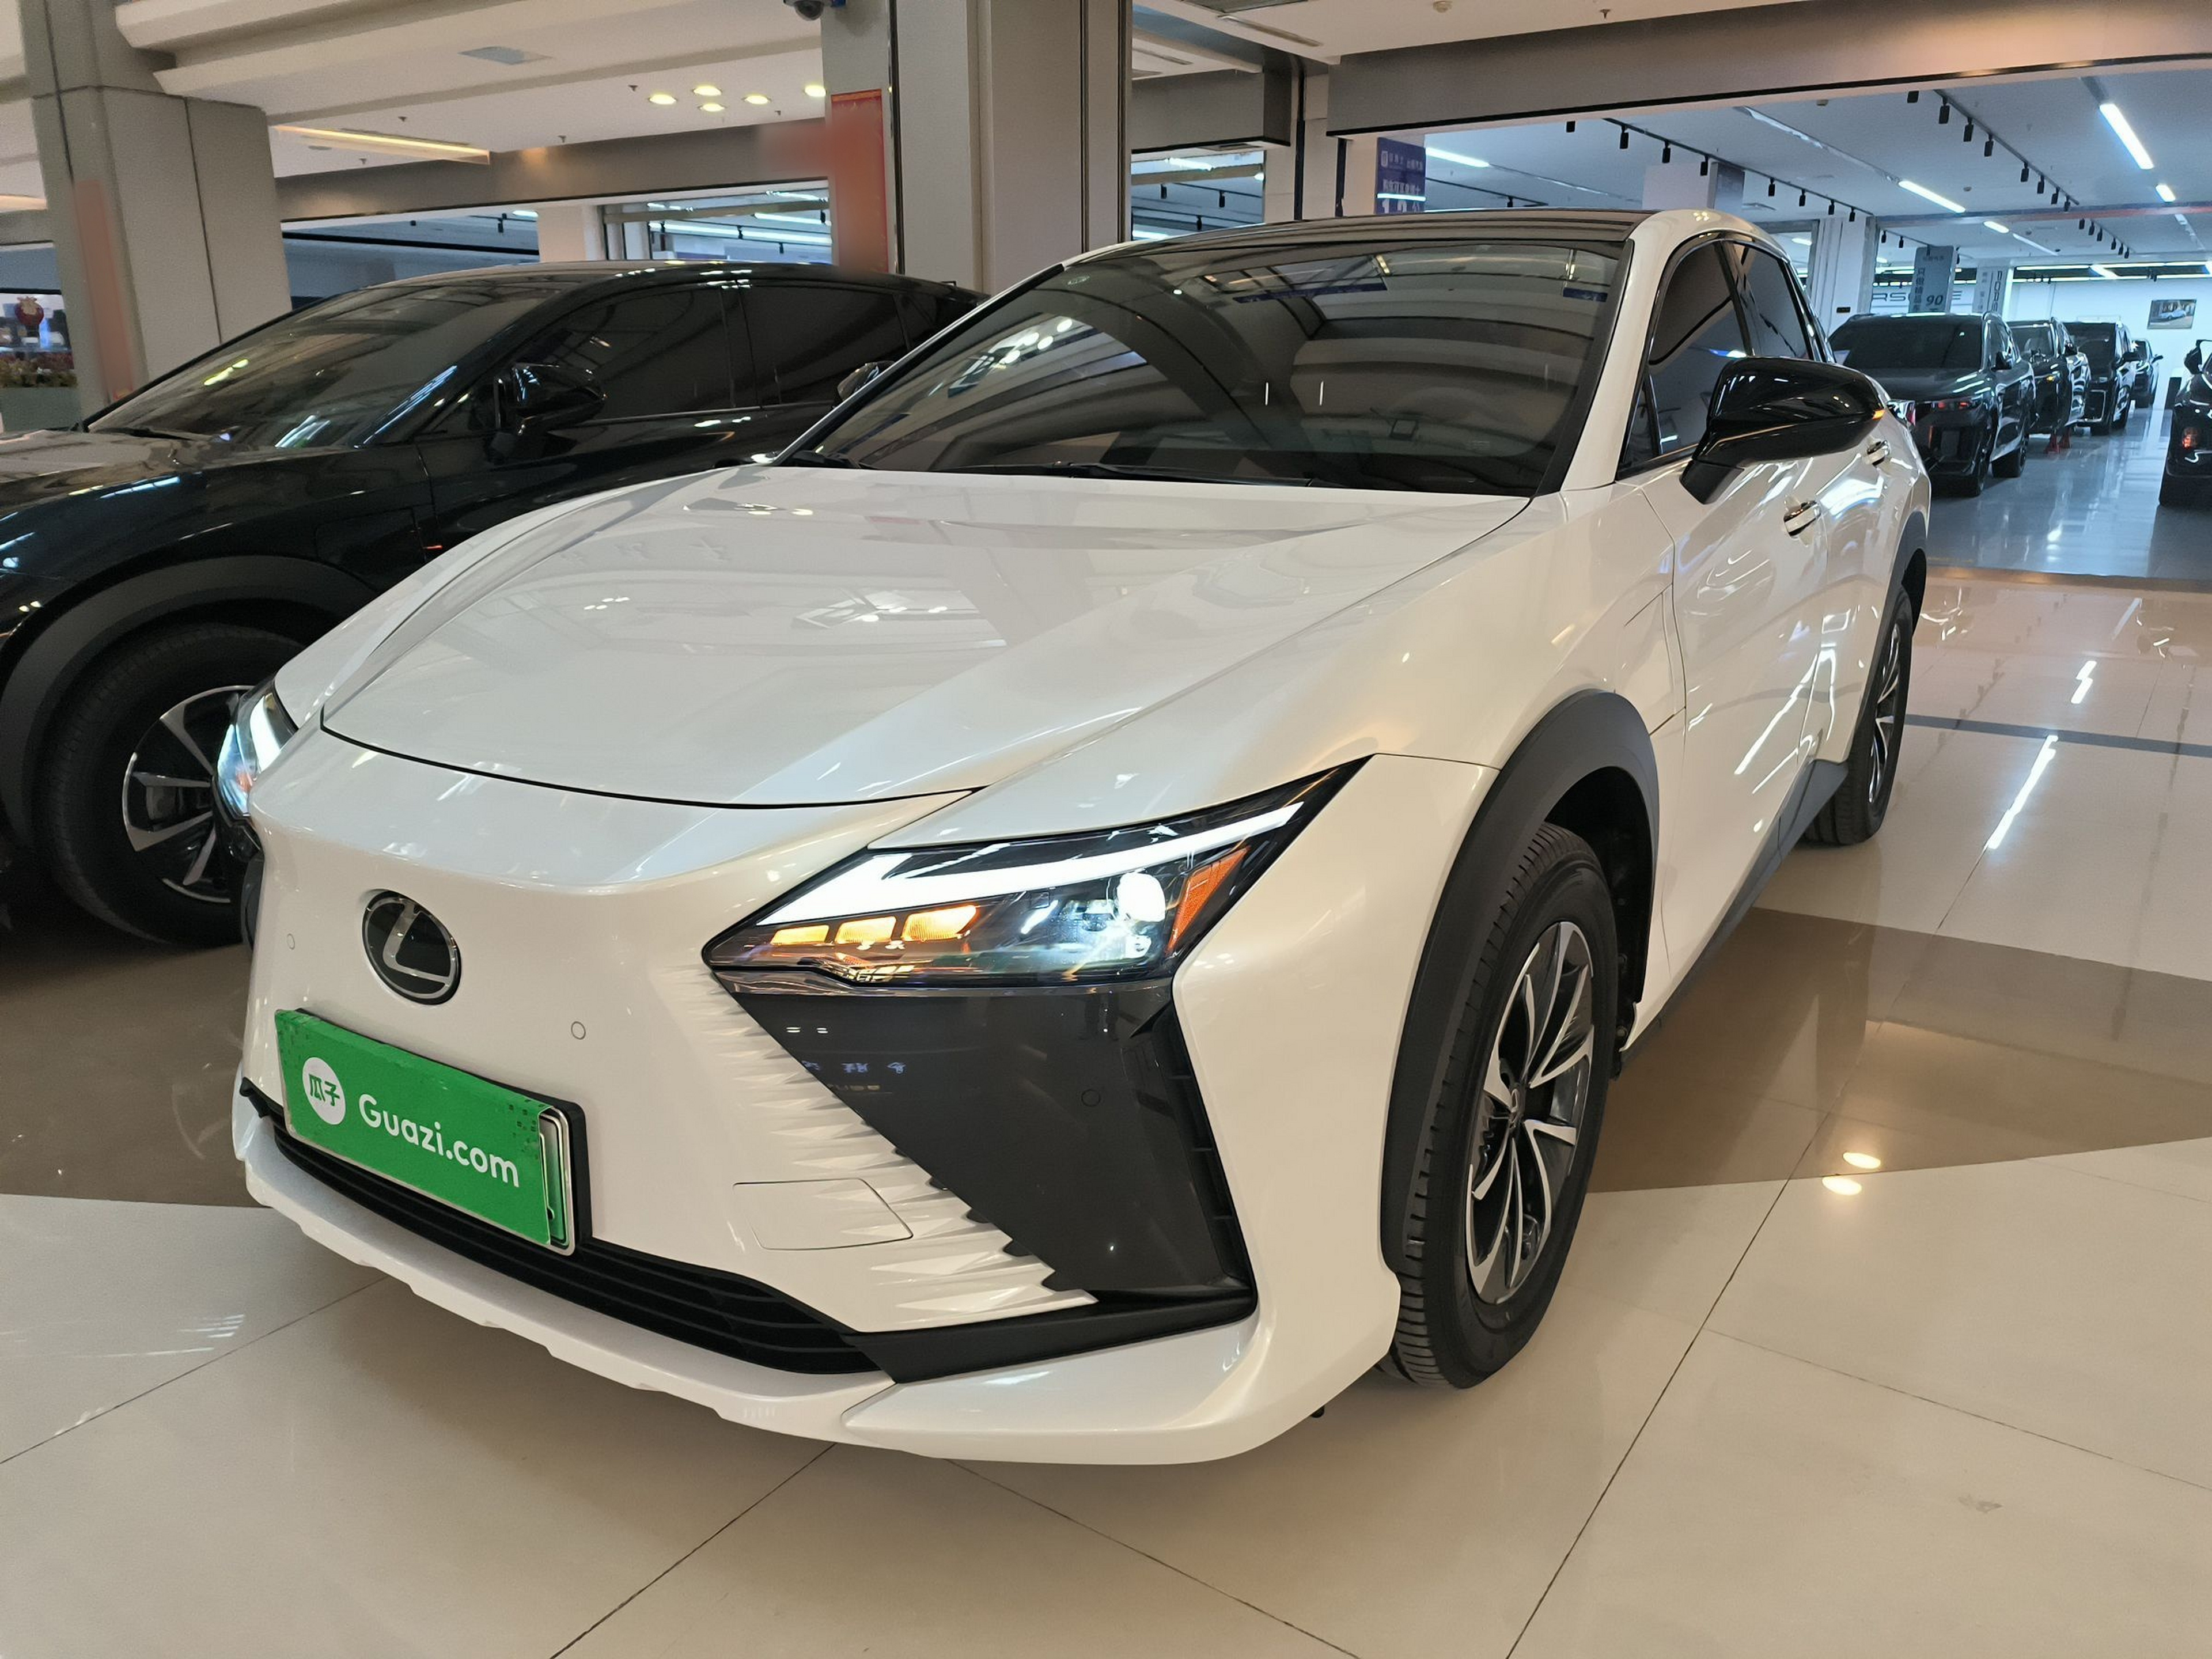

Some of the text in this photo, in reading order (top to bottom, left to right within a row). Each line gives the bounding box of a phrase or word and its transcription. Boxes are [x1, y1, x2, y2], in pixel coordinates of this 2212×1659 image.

[1926, 295, 1944, 306] 90
[308, 1074, 340, 1106] 瓜子
[359, 1094, 520, 1188] Guazi.com
